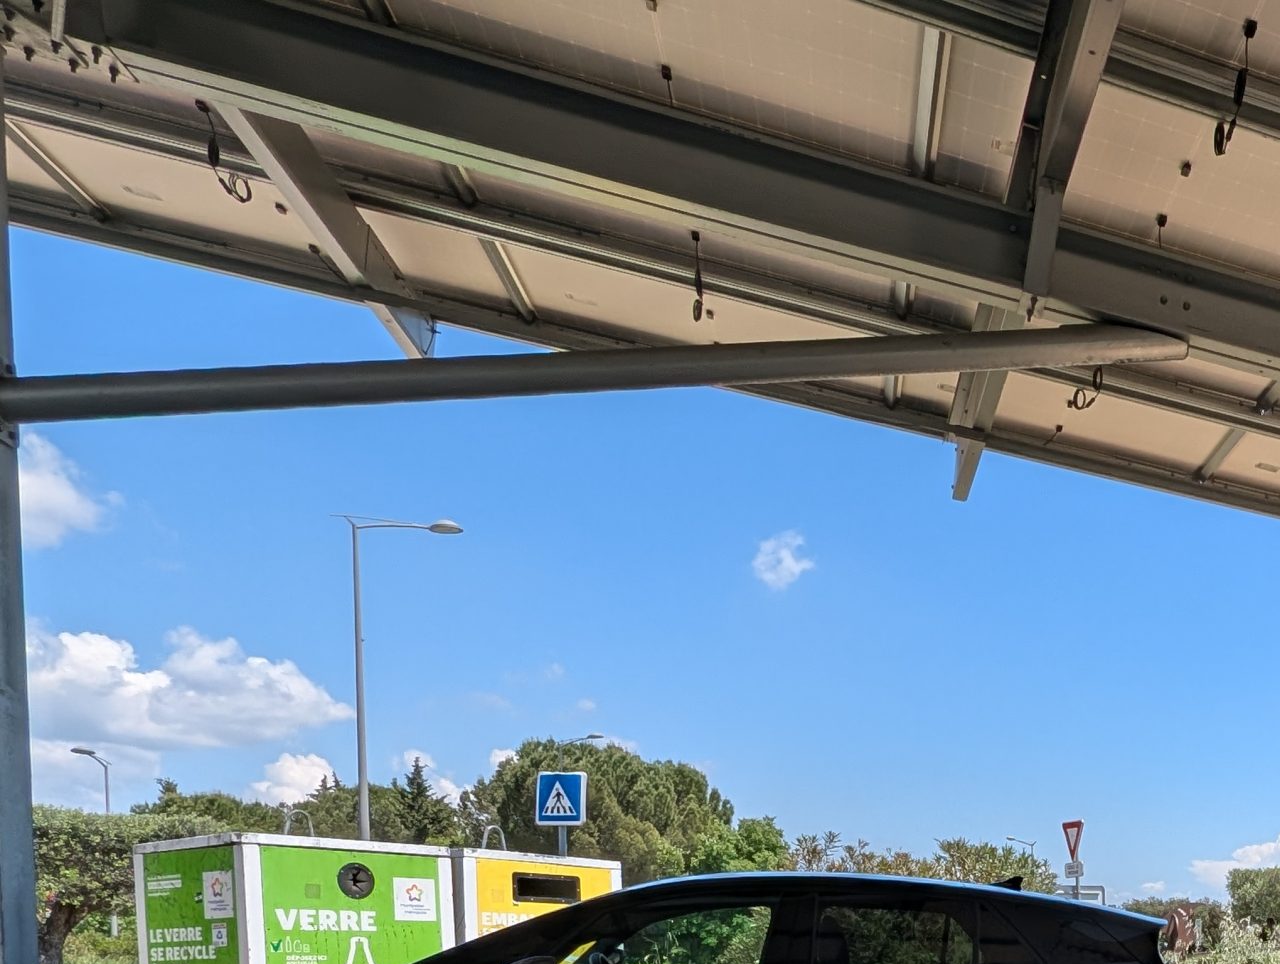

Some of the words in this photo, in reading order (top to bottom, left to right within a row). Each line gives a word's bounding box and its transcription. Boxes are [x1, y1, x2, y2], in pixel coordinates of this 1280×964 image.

[274, 908, 378, 931] VERRE
[149, 928, 163, 943] LE
[164, 926, 203, 942] VERRE
[150, 946, 164, 961] SE
[165, 945, 217, 960] RECYCLE
